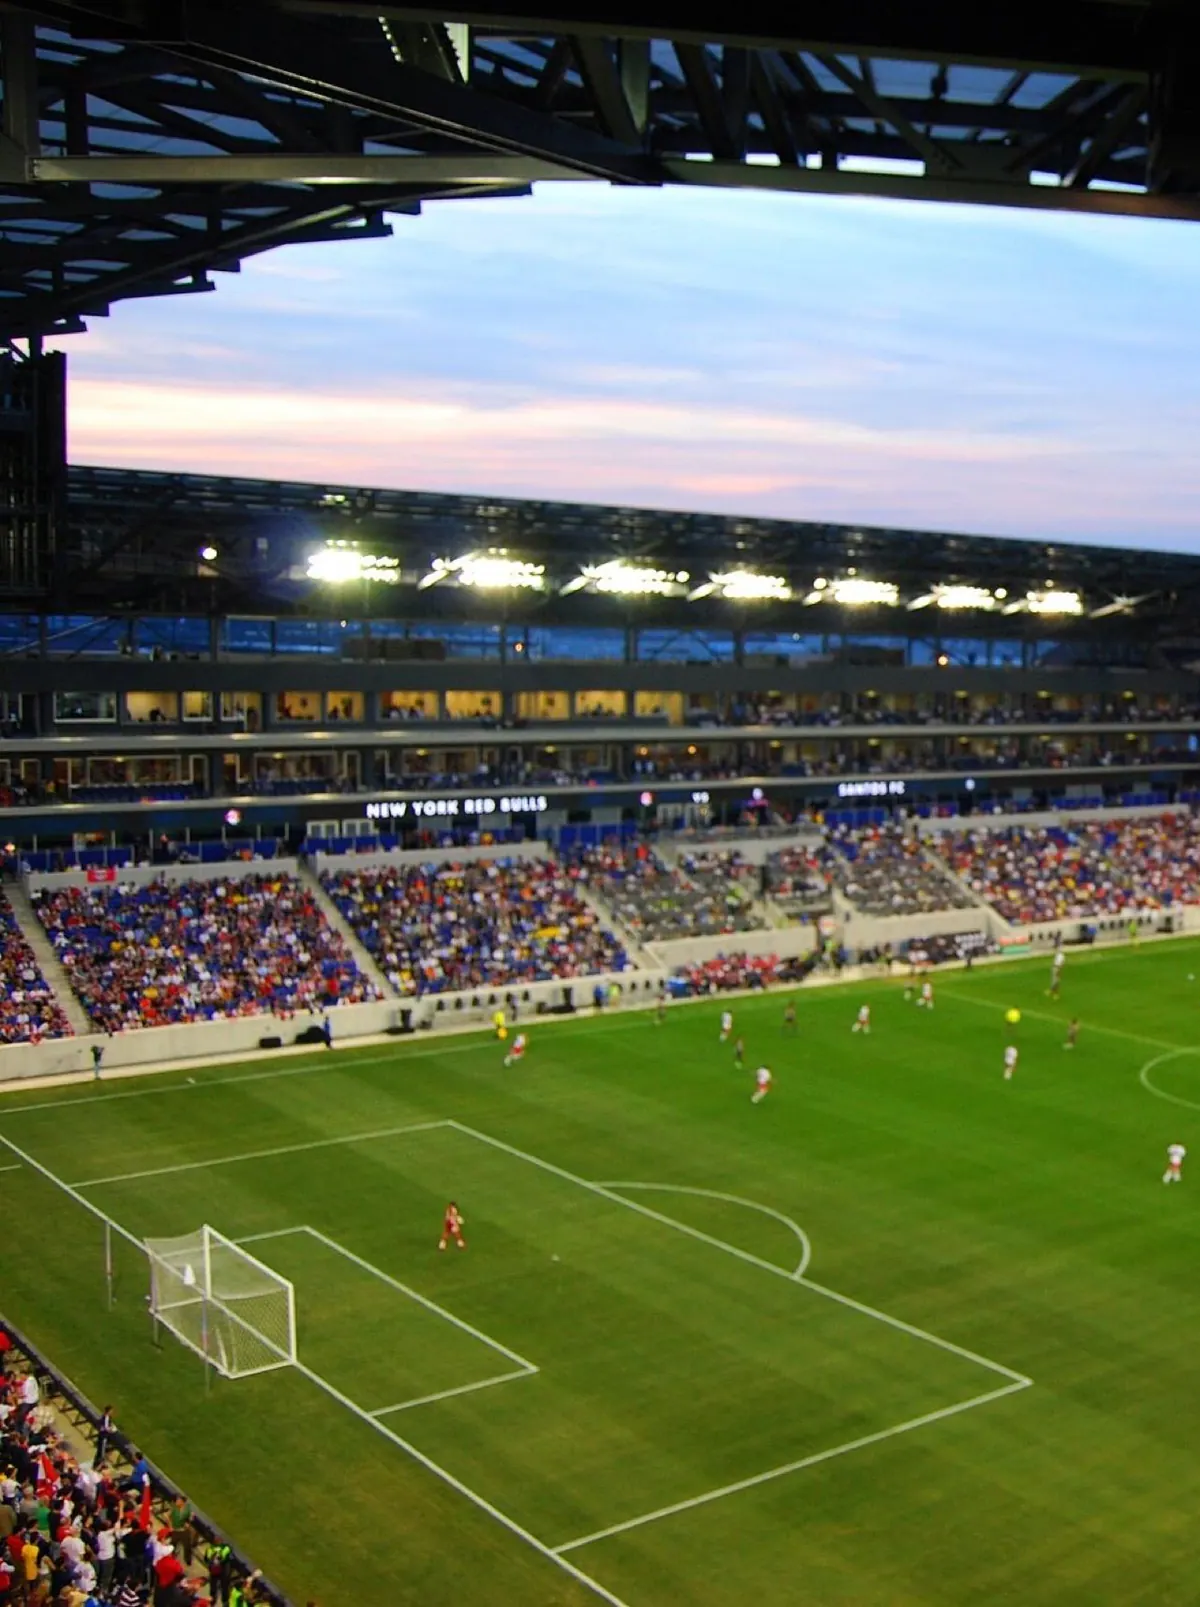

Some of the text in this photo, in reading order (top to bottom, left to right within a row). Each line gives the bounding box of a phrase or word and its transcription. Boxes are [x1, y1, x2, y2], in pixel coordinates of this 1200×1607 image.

[366, 796, 548, 818] NEW YORK RED BULLS
